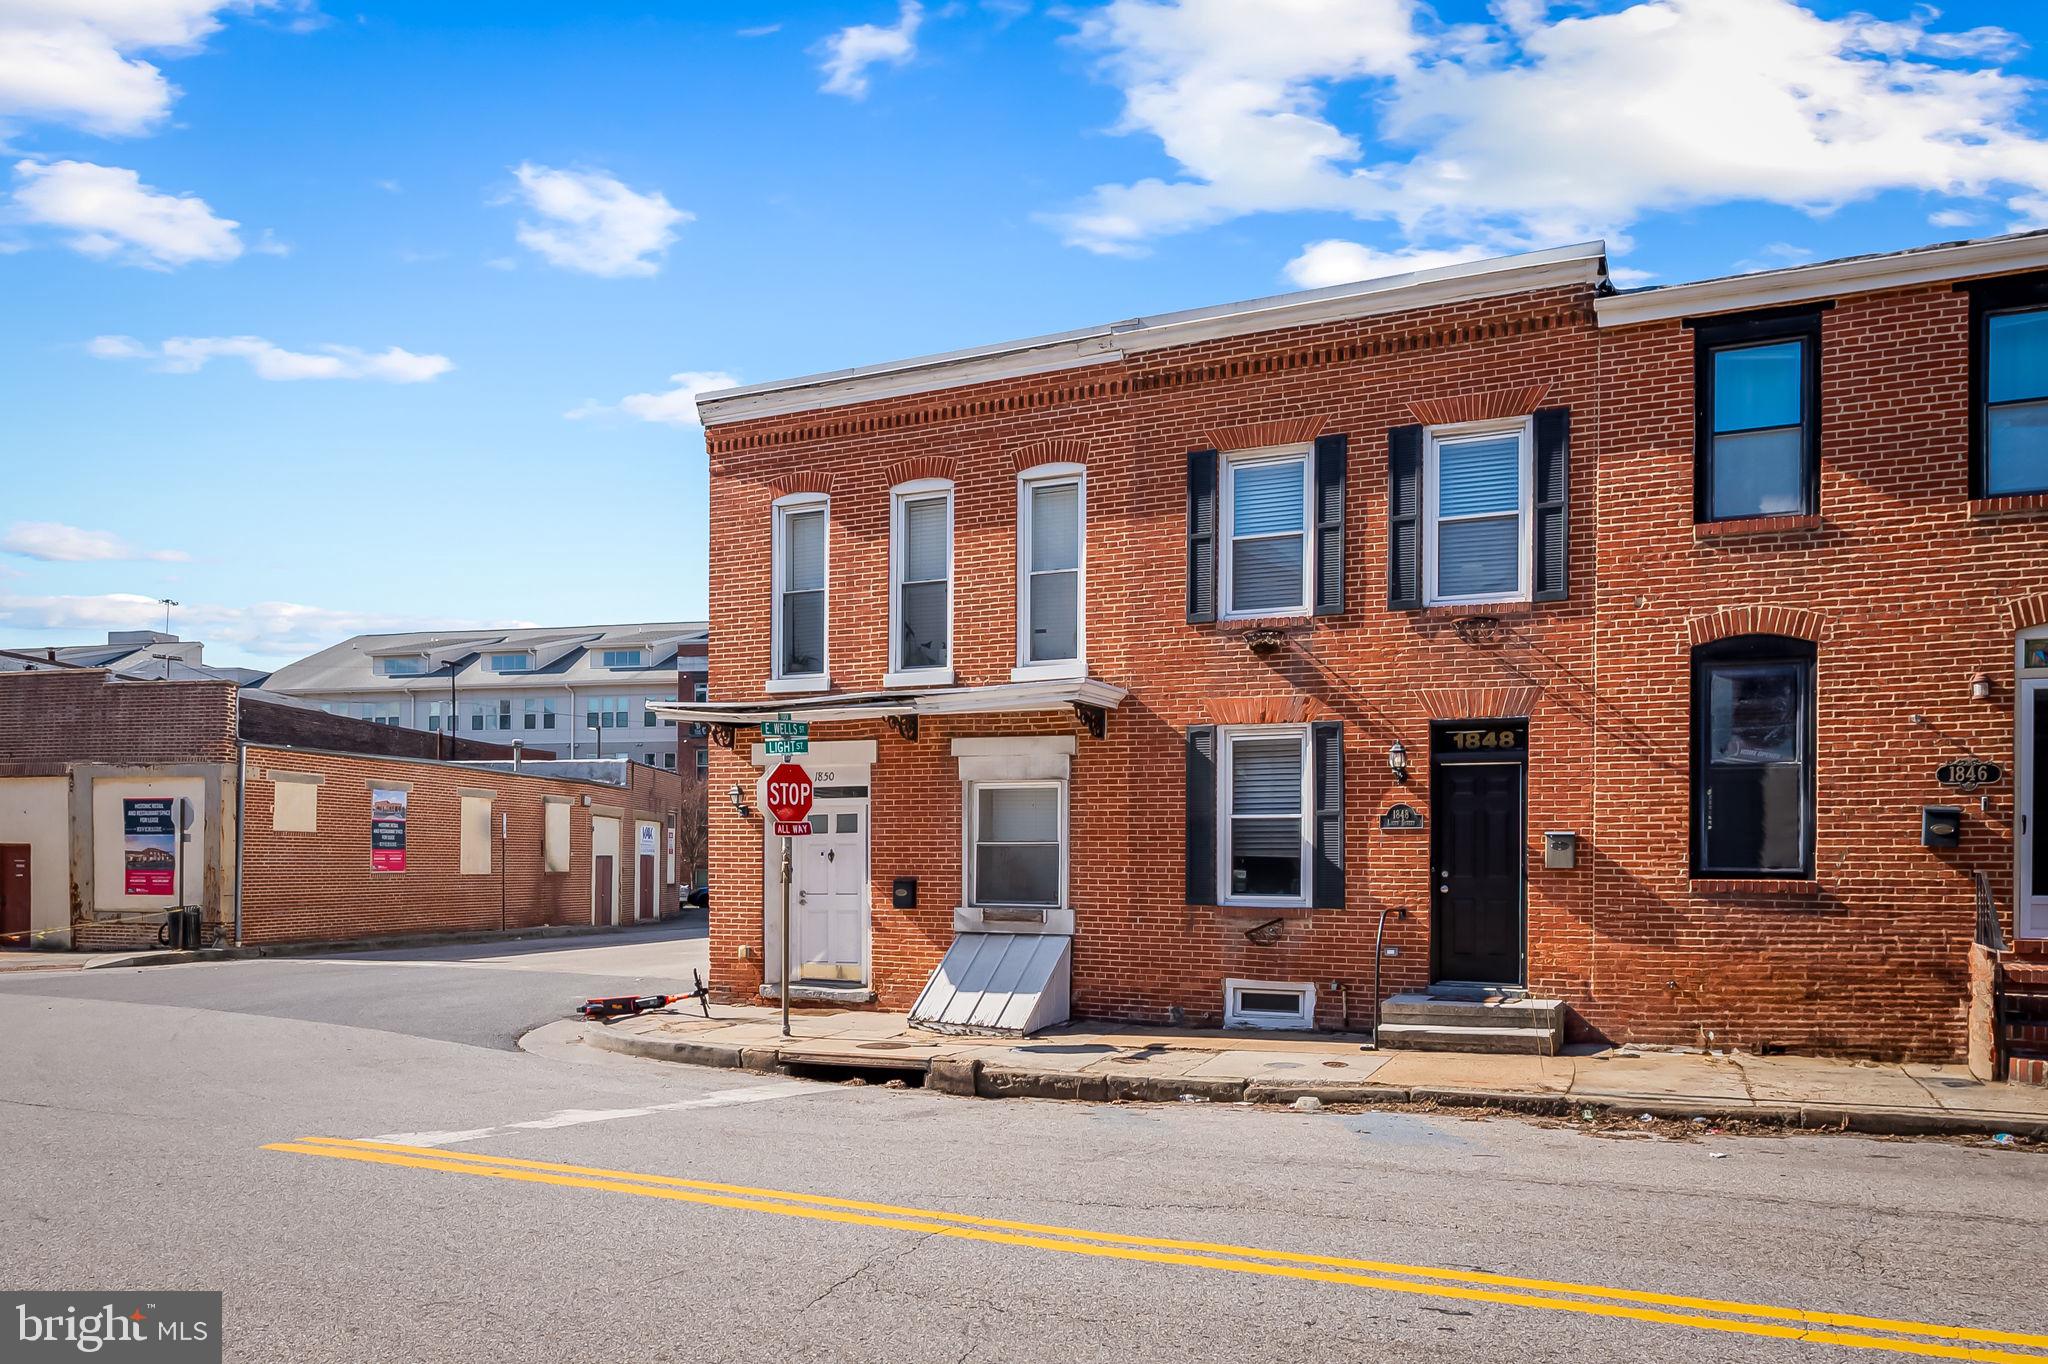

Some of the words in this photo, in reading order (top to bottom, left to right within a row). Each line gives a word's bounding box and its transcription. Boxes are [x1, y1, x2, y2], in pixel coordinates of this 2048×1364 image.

[774, 723, 798, 735] WELLS
[1453, 731, 1515, 749] 1848
[769, 740, 796, 753] LIGHT
[815, 771, 835, 782] 1850
[1949, 765, 1988, 782] 1846
[769, 782, 811, 806] STOP
[1392, 809, 1410, 820] 1848
[777, 825, 790, 834] ALL
[792, 825, 807, 834] WAY
